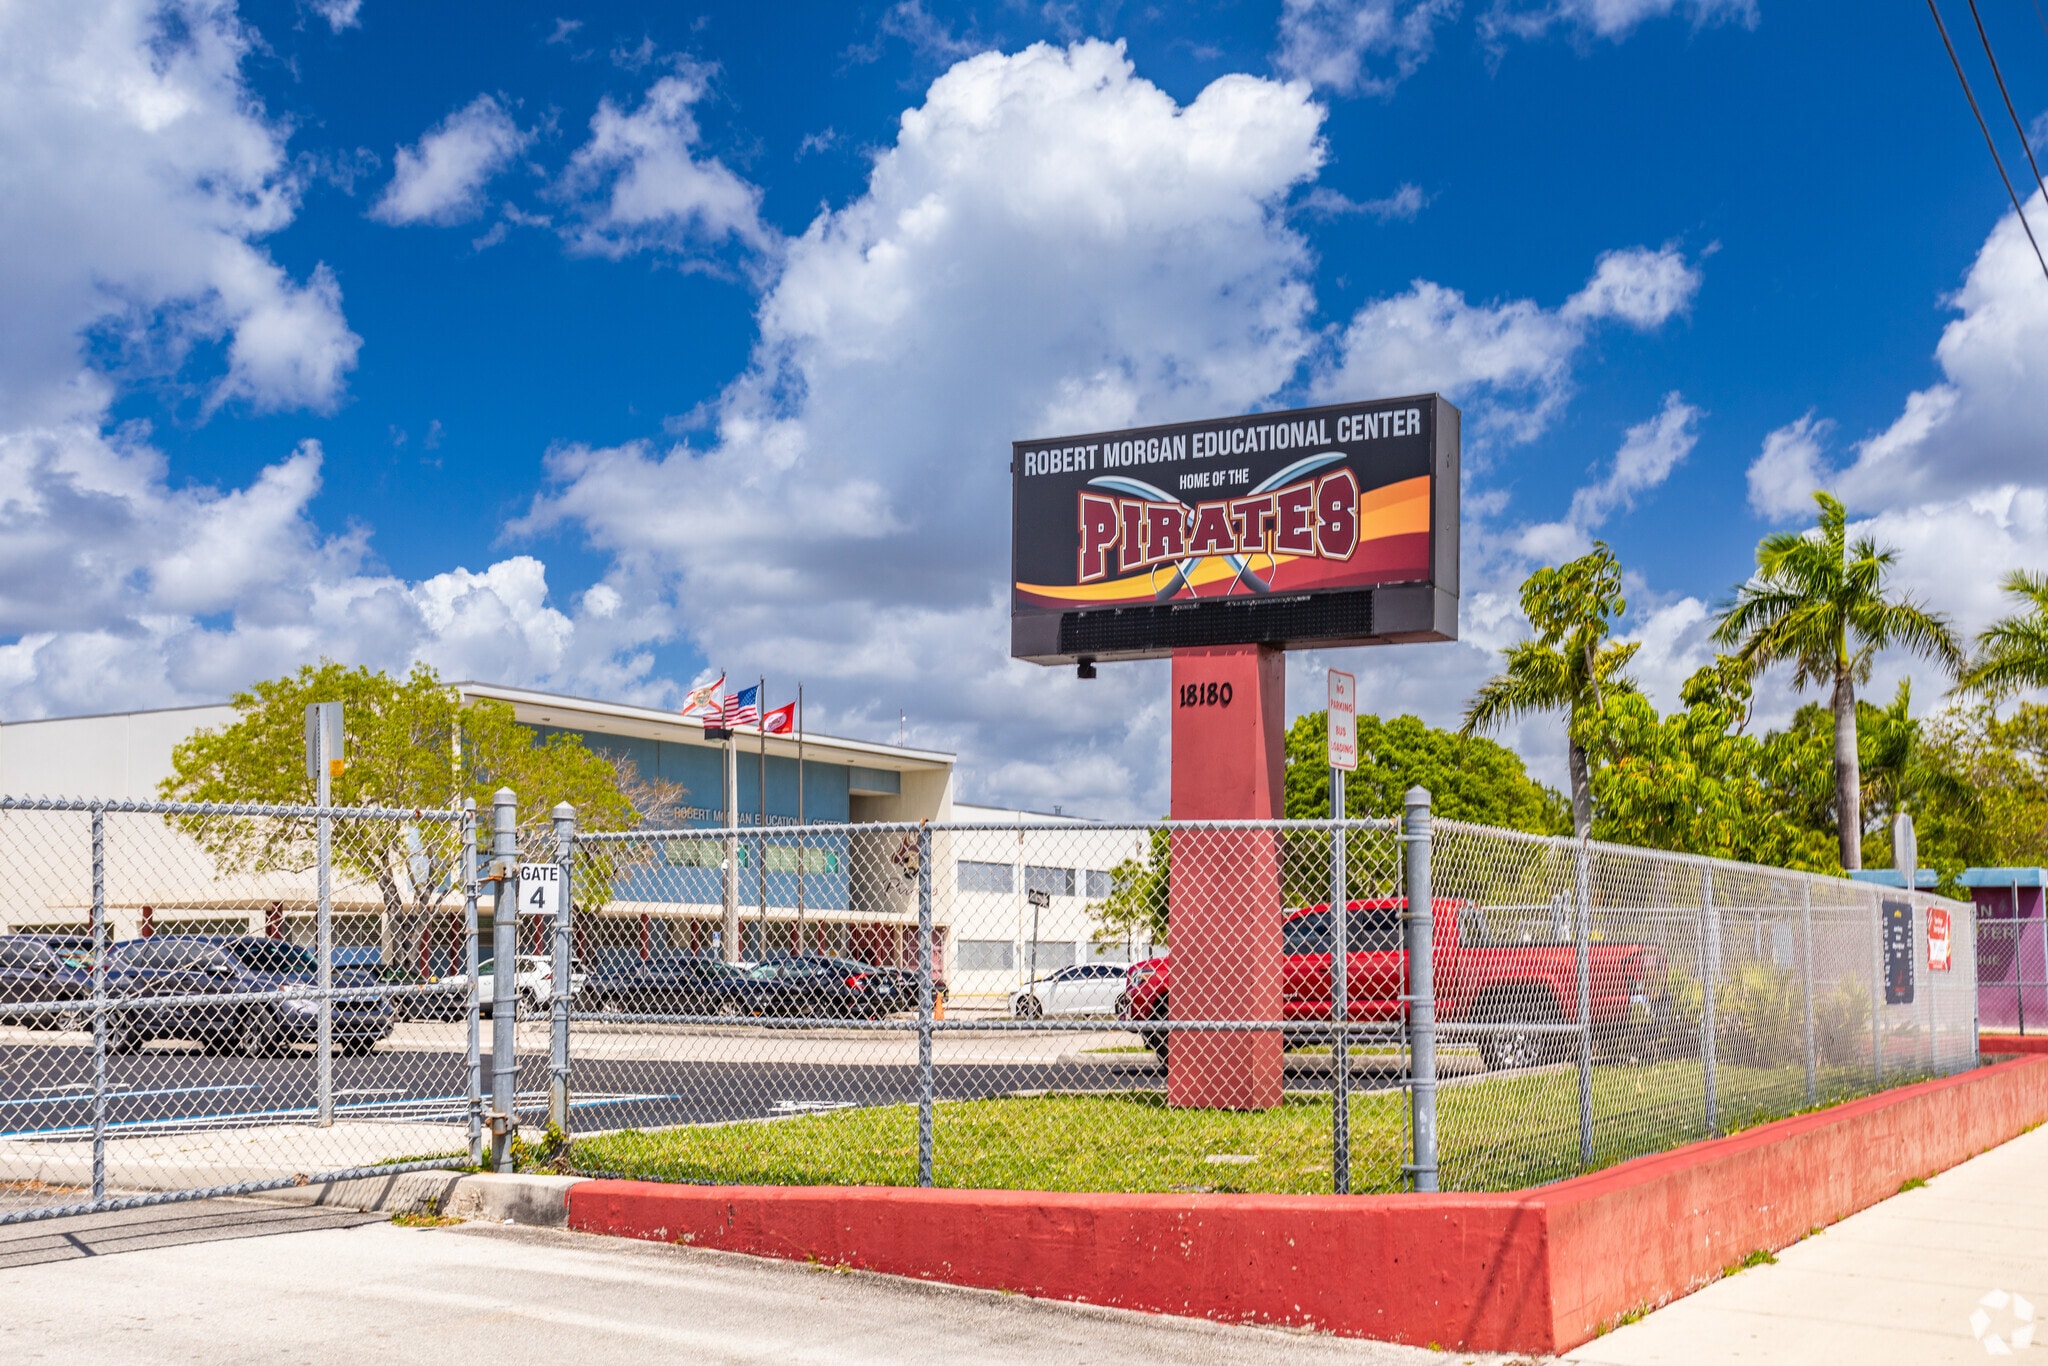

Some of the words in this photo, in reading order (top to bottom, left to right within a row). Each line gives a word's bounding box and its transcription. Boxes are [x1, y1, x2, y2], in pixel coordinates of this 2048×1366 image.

[1024, 445, 1098, 476] ROBERT
[1103, 434, 1186, 468] MORGAN
[1192, 418, 1331, 458] EDUCATIONAL
[1337, 408, 1421, 442] CENTER
[1179, 472, 1210, 490] HOME
[1212, 471, 1226, 486] OF
[1228, 468, 1249, 485] THE
[1077, 467, 1361, 584] PIRATES
[1179, 682, 1233, 708] 18180
[1336, 684, 1344, 694] NO
[1330, 698, 1353, 713] PARKING
[1335, 725, 1346, 737] BUS
[1330, 741, 1353, 755] LOADING
[521, 866, 558, 881] GATE
[529, 886, 545, 909] 4
